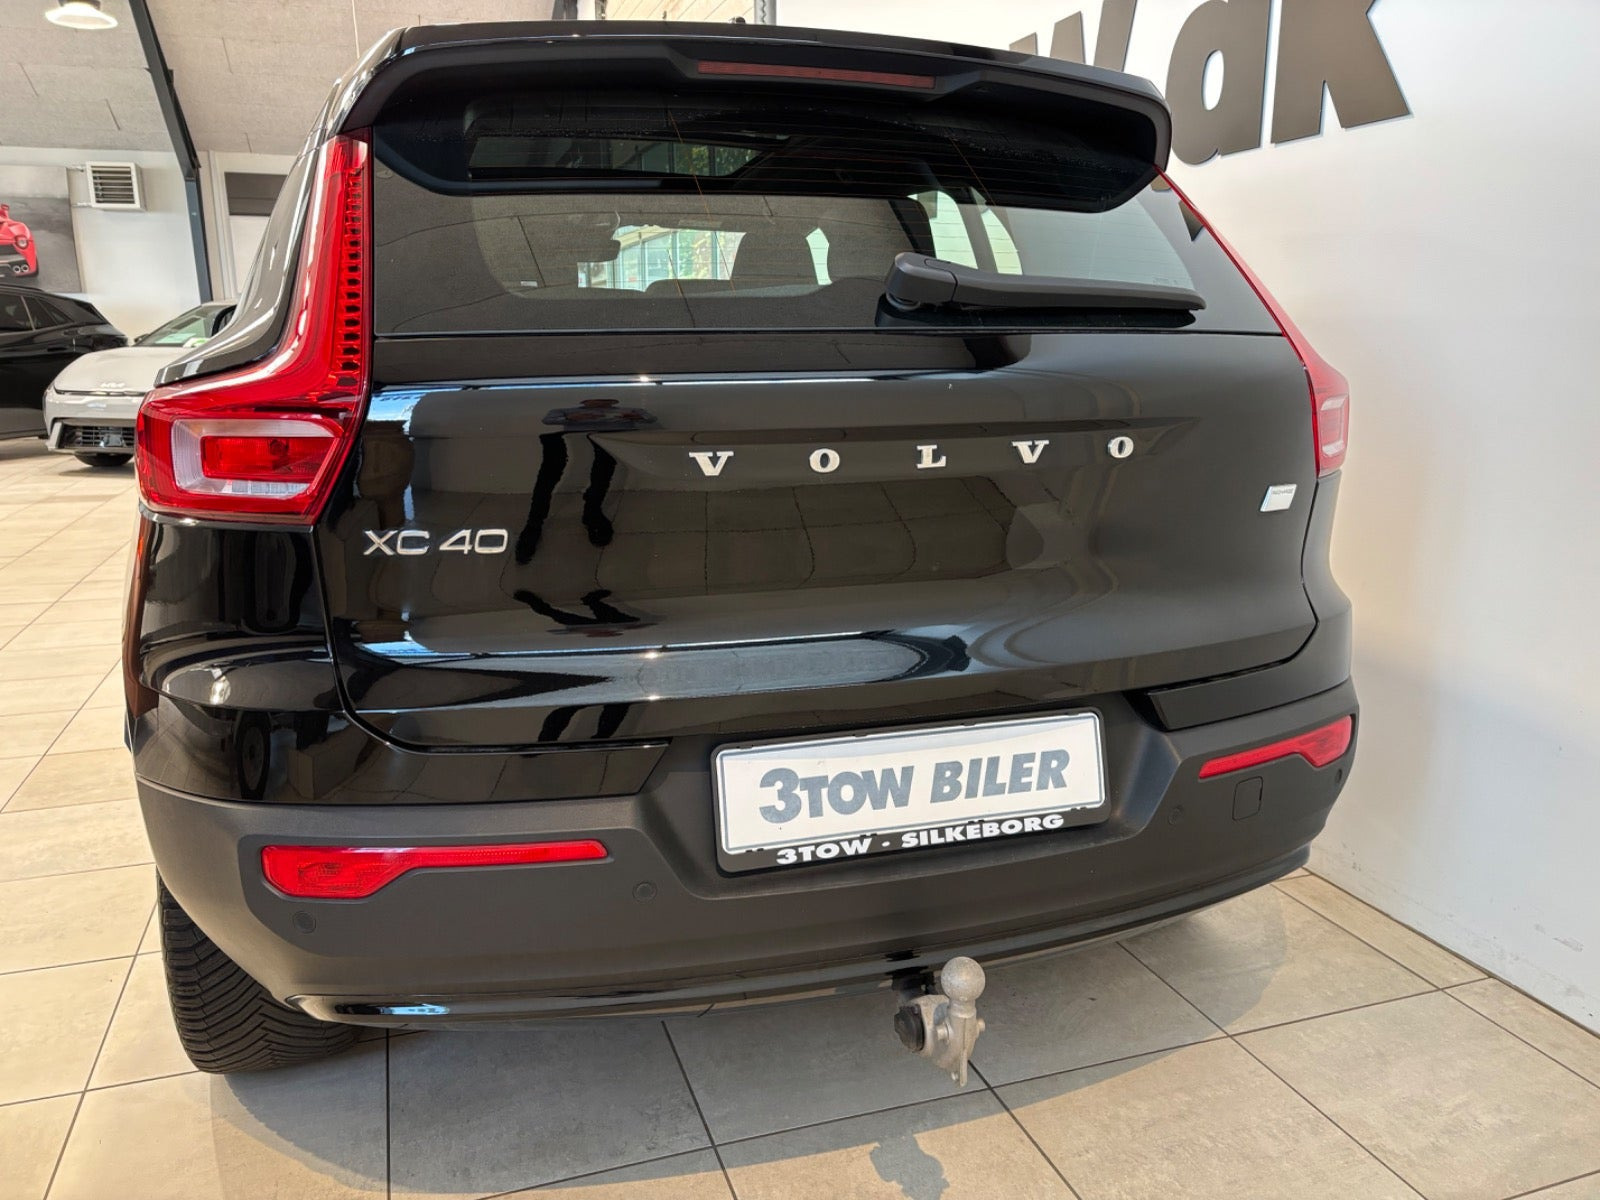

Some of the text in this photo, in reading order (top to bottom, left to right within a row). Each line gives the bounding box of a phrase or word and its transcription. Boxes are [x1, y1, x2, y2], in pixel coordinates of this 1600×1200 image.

[688, 435, 1135, 477] VOLVO
[759, 749, 1071, 824] 3TOW BILER
[776, 813, 1064, 865] 3TOW SILKEBORG
